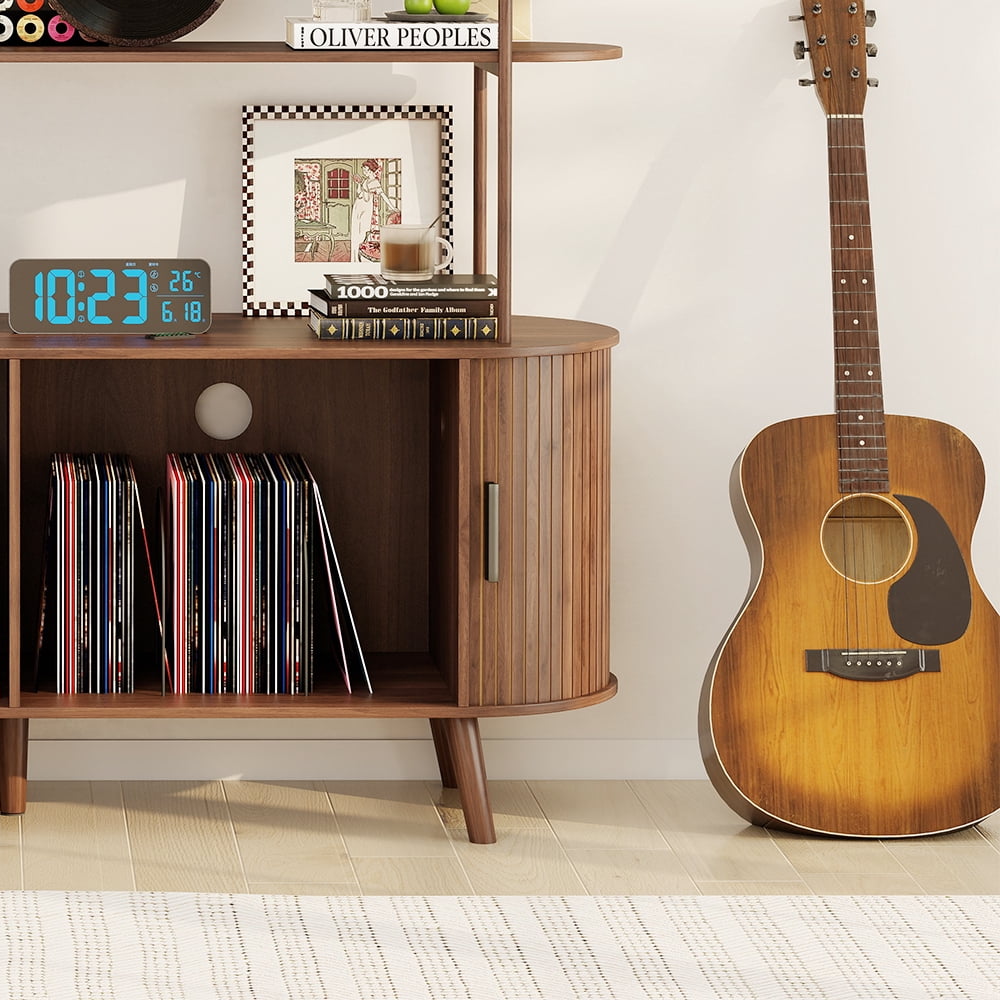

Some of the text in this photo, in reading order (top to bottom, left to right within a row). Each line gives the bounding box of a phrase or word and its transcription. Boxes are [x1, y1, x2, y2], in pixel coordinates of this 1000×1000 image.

[310, 27, 390, 48] OLIVER
[397, 27, 491, 48] PEOPLES
[169, 270, 194, 292] 26
[34, 269, 148, 324] 10:23
[337, 286, 388, 299] 1000
[420, 306, 443, 314] Family
